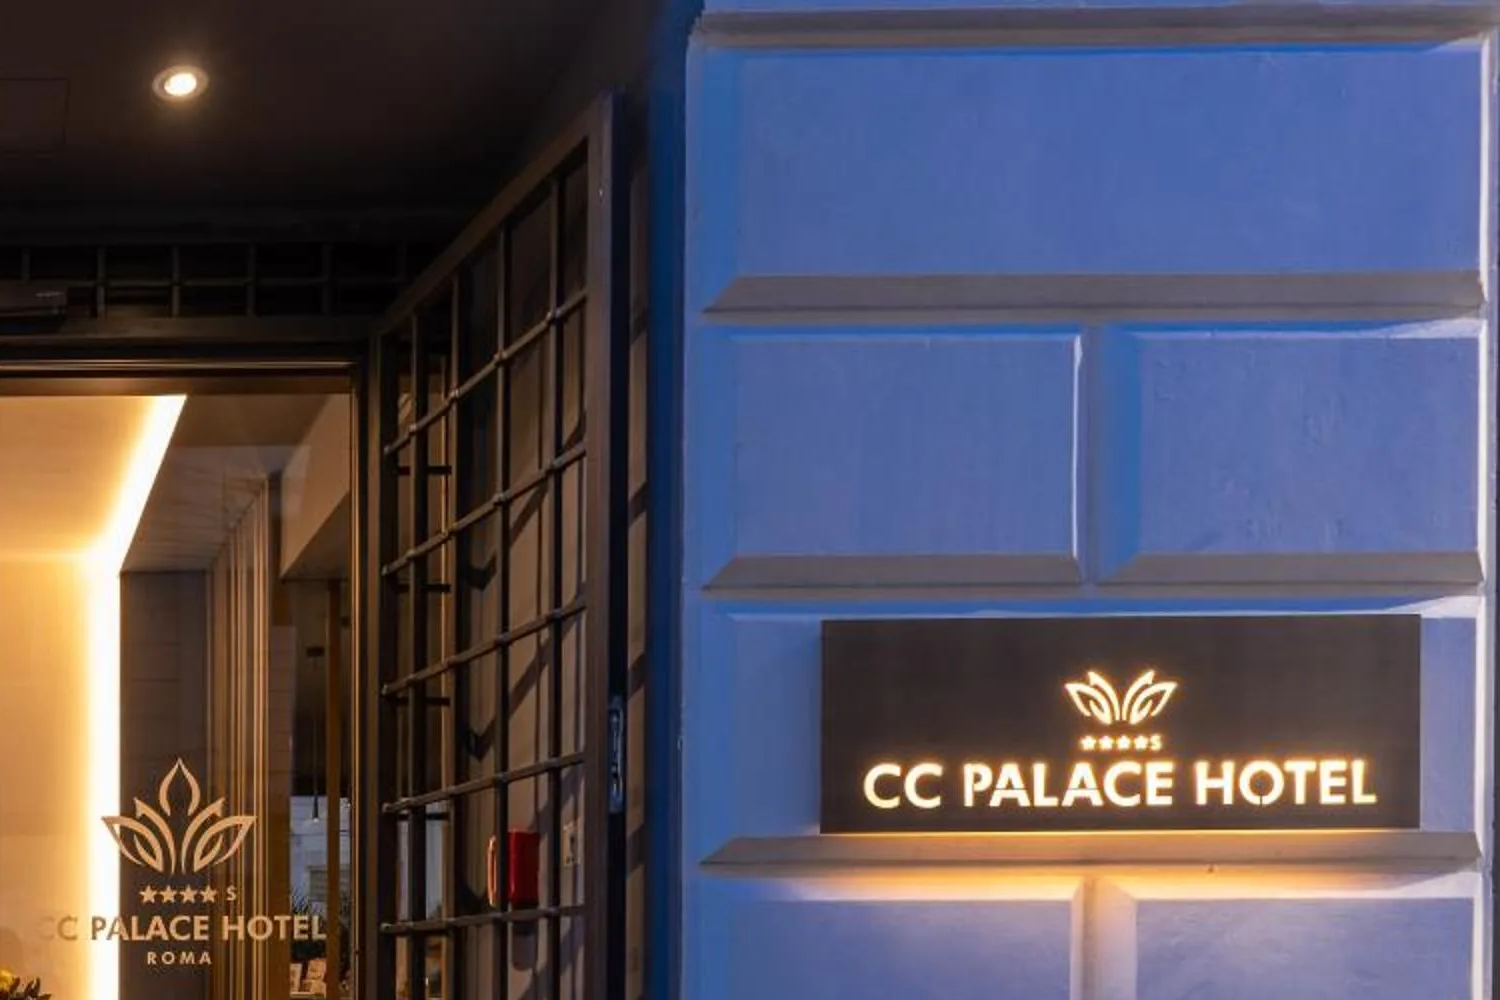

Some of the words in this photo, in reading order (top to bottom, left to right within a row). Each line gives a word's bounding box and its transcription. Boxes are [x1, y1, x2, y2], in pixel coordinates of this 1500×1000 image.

[863, 763, 943, 808] CC
[963, 761, 1174, 807] PALACE
[1196, 760, 1377, 806] HOTEL
[227, 886, 237, 901] S
[37, 916, 78, 942] CC
[90, 915, 210, 942] PALACE
[222, 915, 327, 941] HOTEL
[146, 951, 212, 965] ROMA
